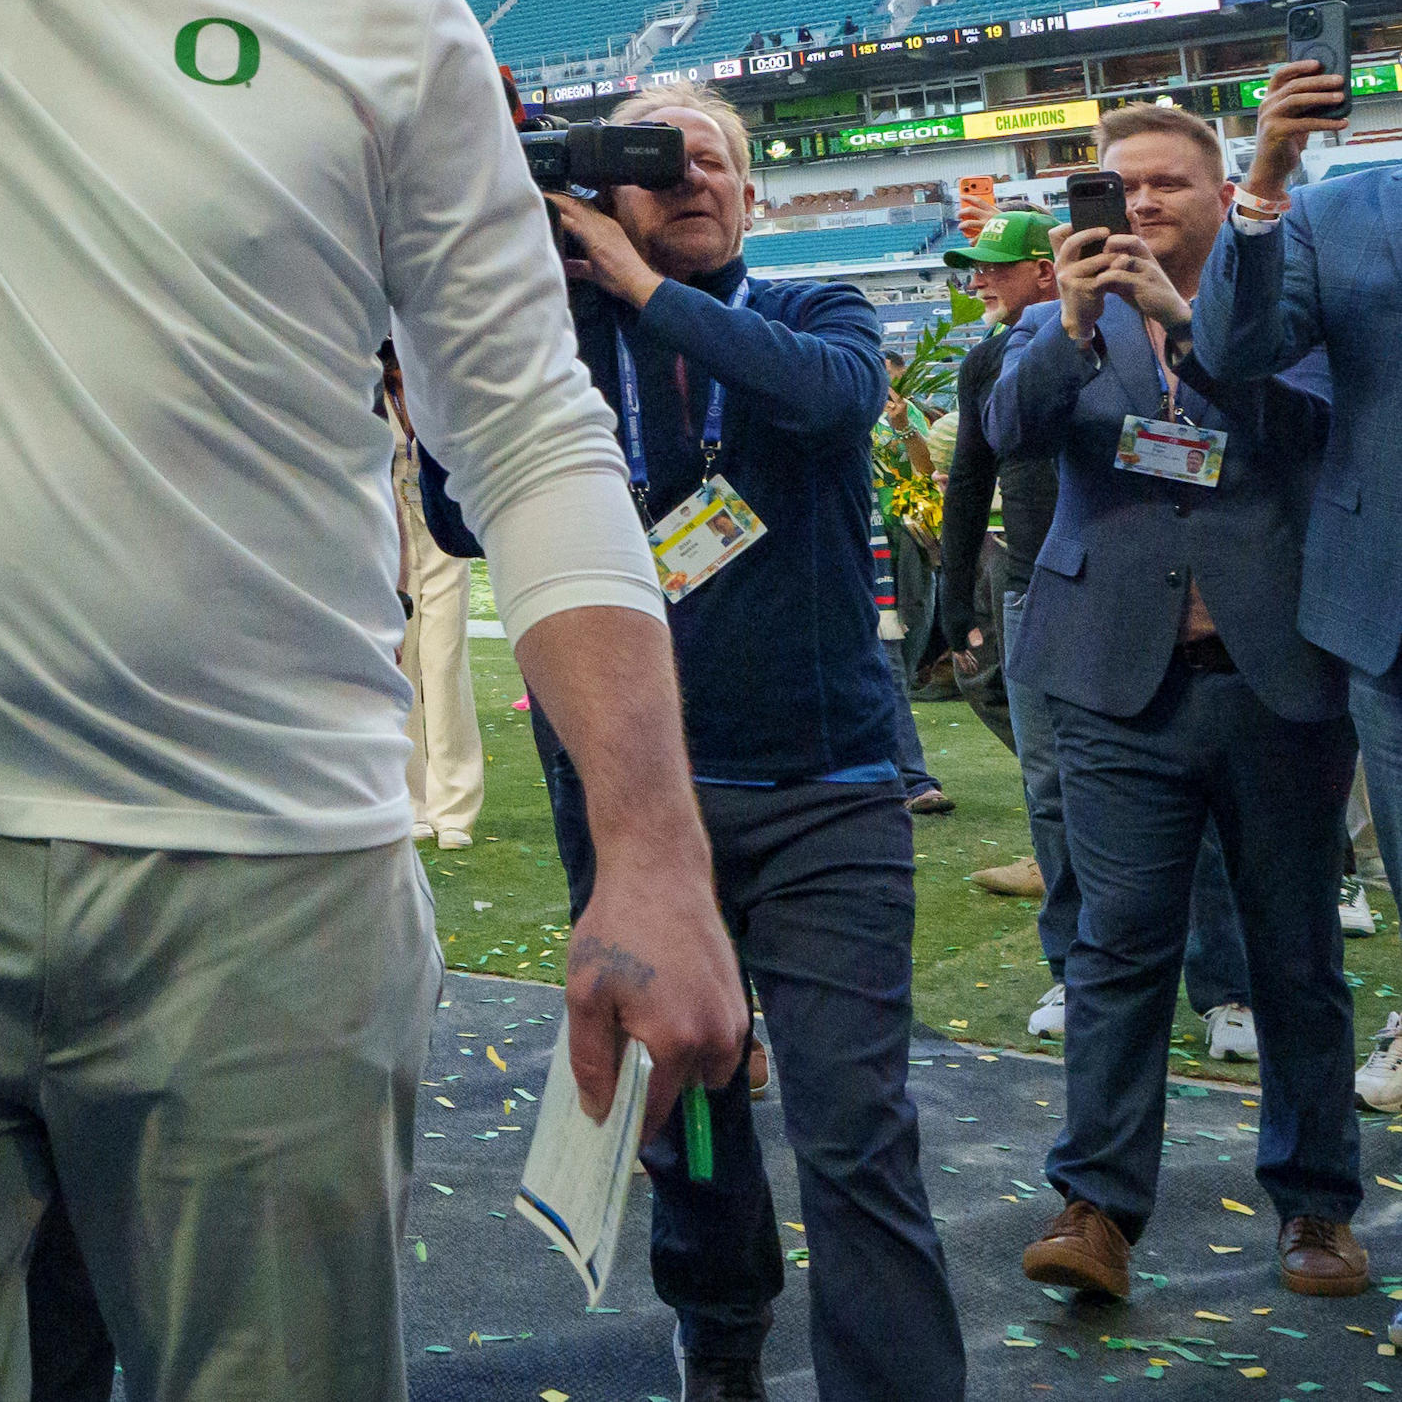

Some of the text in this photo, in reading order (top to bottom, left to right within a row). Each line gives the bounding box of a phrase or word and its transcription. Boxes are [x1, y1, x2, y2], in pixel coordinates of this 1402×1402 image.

[984, 25, 1003, 39] 19
[1019, 16, 1065, 34] 3:45 PM
[174, 17, 261, 86] O
[858, 44, 878, 55] 1ST
[905, 36, 923, 49] 10
[756, 56, 785, 70] 0:00
[806, 51, 826, 63] 4TH
[719, 63, 735, 75] 25
[554, 84, 593, 101] OREGON
[597, 81, 613, 95] 23
[995, 109, 1066, 131] CHAMPIONS
